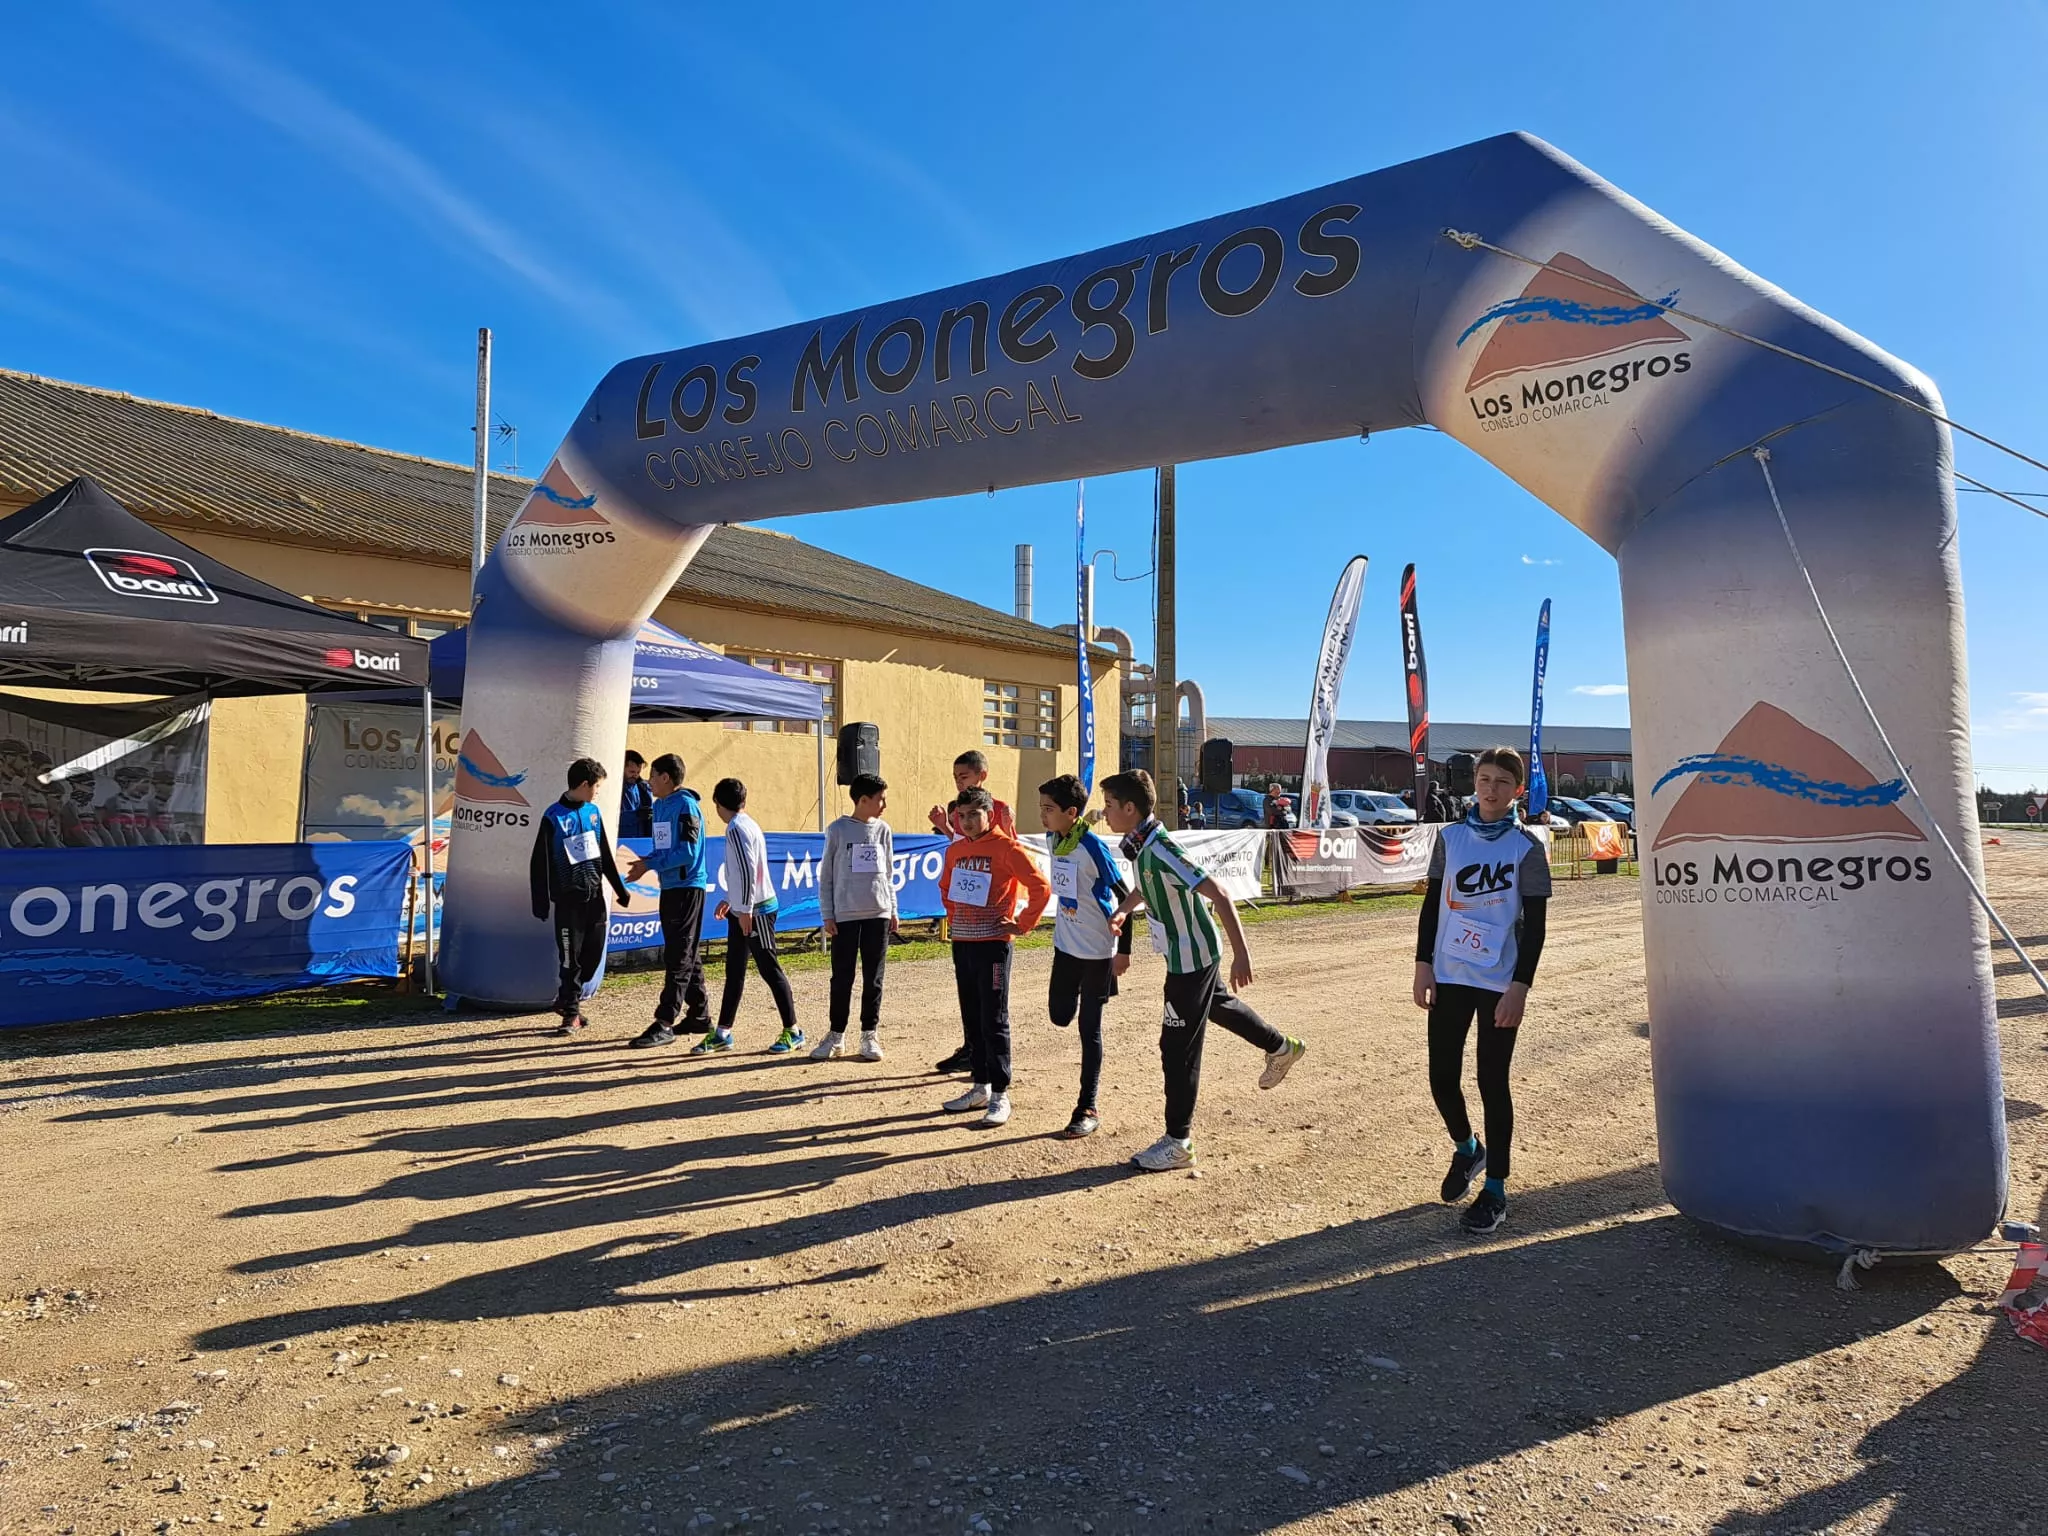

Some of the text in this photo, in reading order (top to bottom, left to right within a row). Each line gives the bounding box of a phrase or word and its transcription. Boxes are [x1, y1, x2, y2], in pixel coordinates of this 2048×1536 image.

[635, 203, 1363, 440] Los Monegros
[1470, 352, 1692, 420] Los Monegros
[1481, 392, 1611, 433] CONSEJO COMARCAL
[645, 375, 1083, 491] CONSEJO COMARCAL
[507, 530, 616, 549] Los Monegros
[505, 547, 577, 557] CONSEJO COMARCAL
[108, 571, 204, 597] barri
[0, 621, 28, 643] rri
[1405, 613, 1419, 670] barri
[354, 649, 400, 671] barri
[632, 676, 659, 689] ros
[343, 719, 402, 752] Los
[1083, 712, 1094, 758] Los
[344, 754, 418, 770] CONSEJO
[454, 804, 530, 828] onegros
[864, 850, 878, 862] 23
[1319, 829, 1357, 859] barri
[1455, 861, 1515, 894] CNS
[1654, 852, 1932, 890] Los Monegros
[960, 879, 976, 892] 35
[1656, 886, 1840, 904] CONSEJO COMARCAL
[0, 875, 358, 942] onegros
[607, 935, 643, 945] OMARCAL
[610, 920, 662, 938] onegr
[1461, 928, 1482, 950] 75
